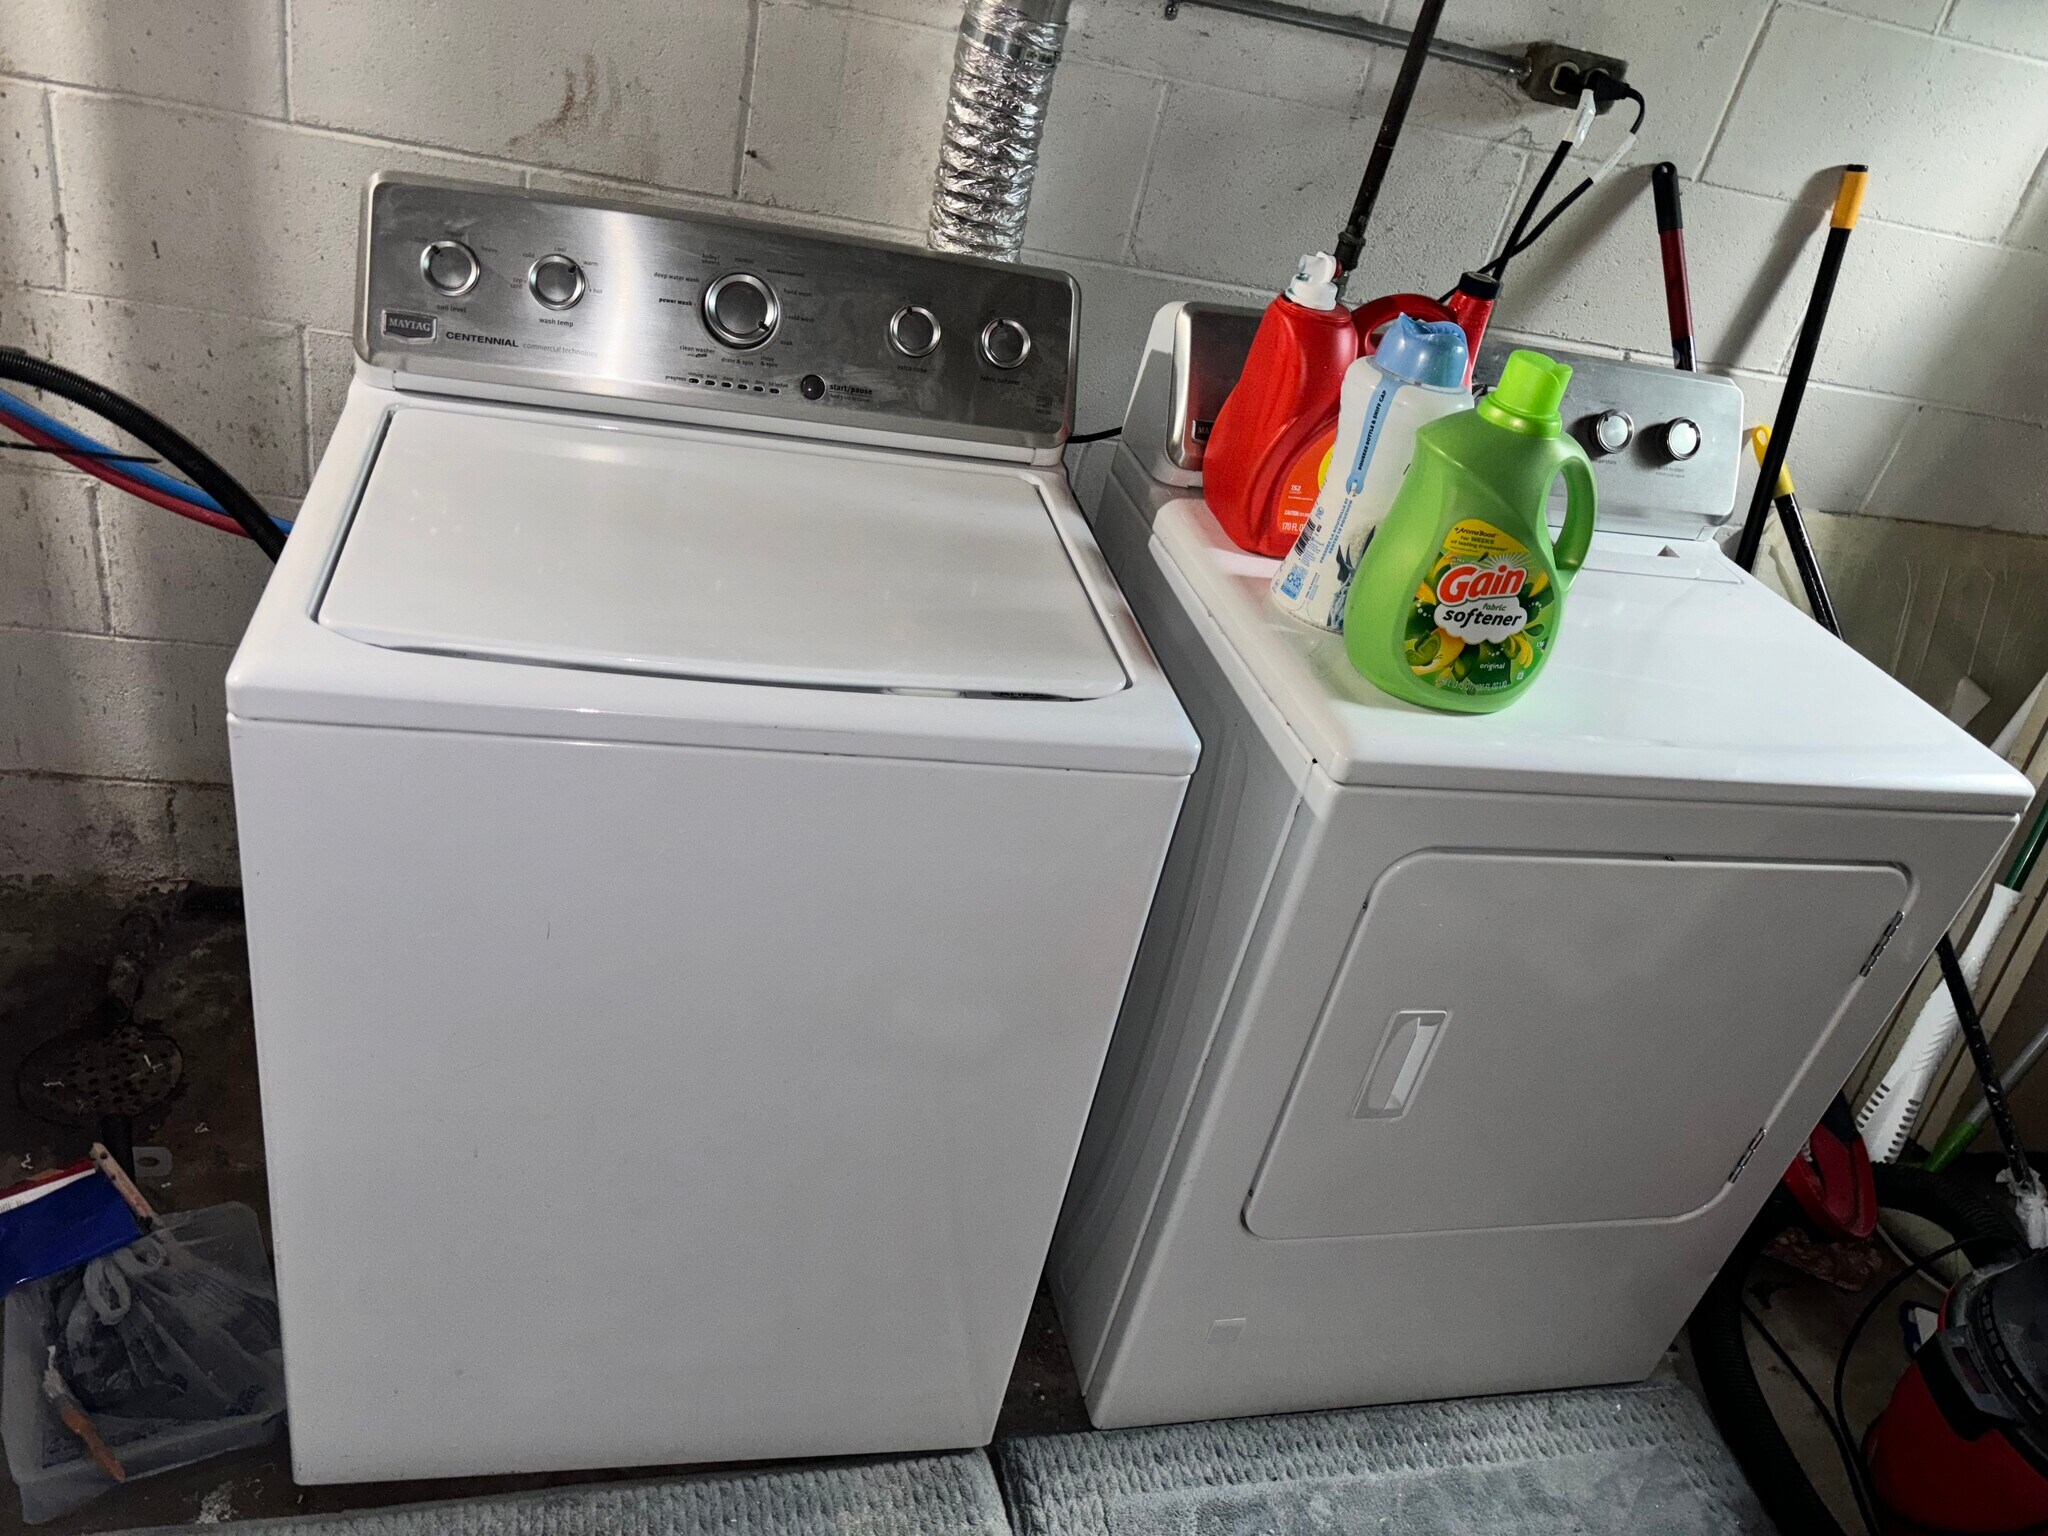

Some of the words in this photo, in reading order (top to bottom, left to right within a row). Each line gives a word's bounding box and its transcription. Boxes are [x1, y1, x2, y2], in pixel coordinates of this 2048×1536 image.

[653, 272, 668, 280] deep
[450, 305, 467, 313] level
[388, 317, 431, 332] MAYTAG
[538, 317, 556, 325] wash
[557, 319, 574, 328] temp
[445, 331, 519, 348] CENTENNIAL
[522, 342, 562, 353] commercial
[562, 346, 599, 359] technology
[679, 344, 695, 352] clean
[695, 346, 716, 354] washer
[829, 383, 873, 396] start/pause
[1379, 390, 1387, 402] CAP
[1470, 536, 1495, 545] WEEKS
[1438, 564, 1526, 604] Gain
[1482, 602, 1507, 612] fabric
[1442, 608, 1523, 629] softener
[1479, 662, 1506, 671] original
